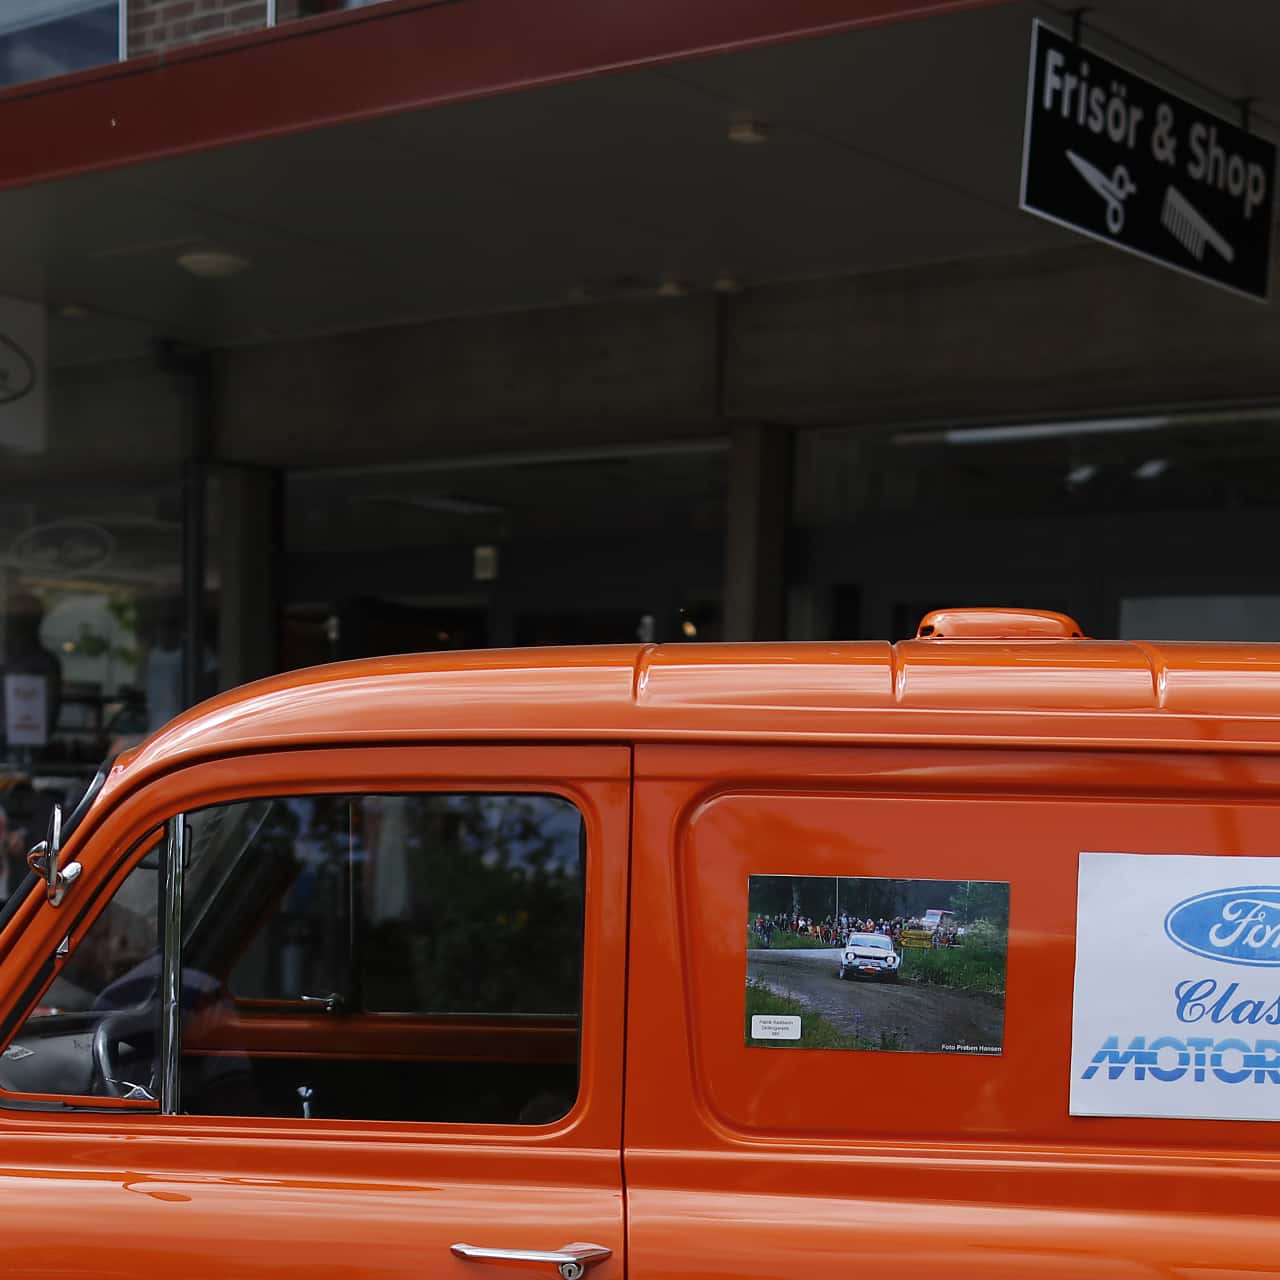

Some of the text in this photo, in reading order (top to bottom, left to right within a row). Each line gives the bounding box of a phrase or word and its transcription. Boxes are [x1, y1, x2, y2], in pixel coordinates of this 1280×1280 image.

[1042, 48, 1266, 219] Frisör & Shop
